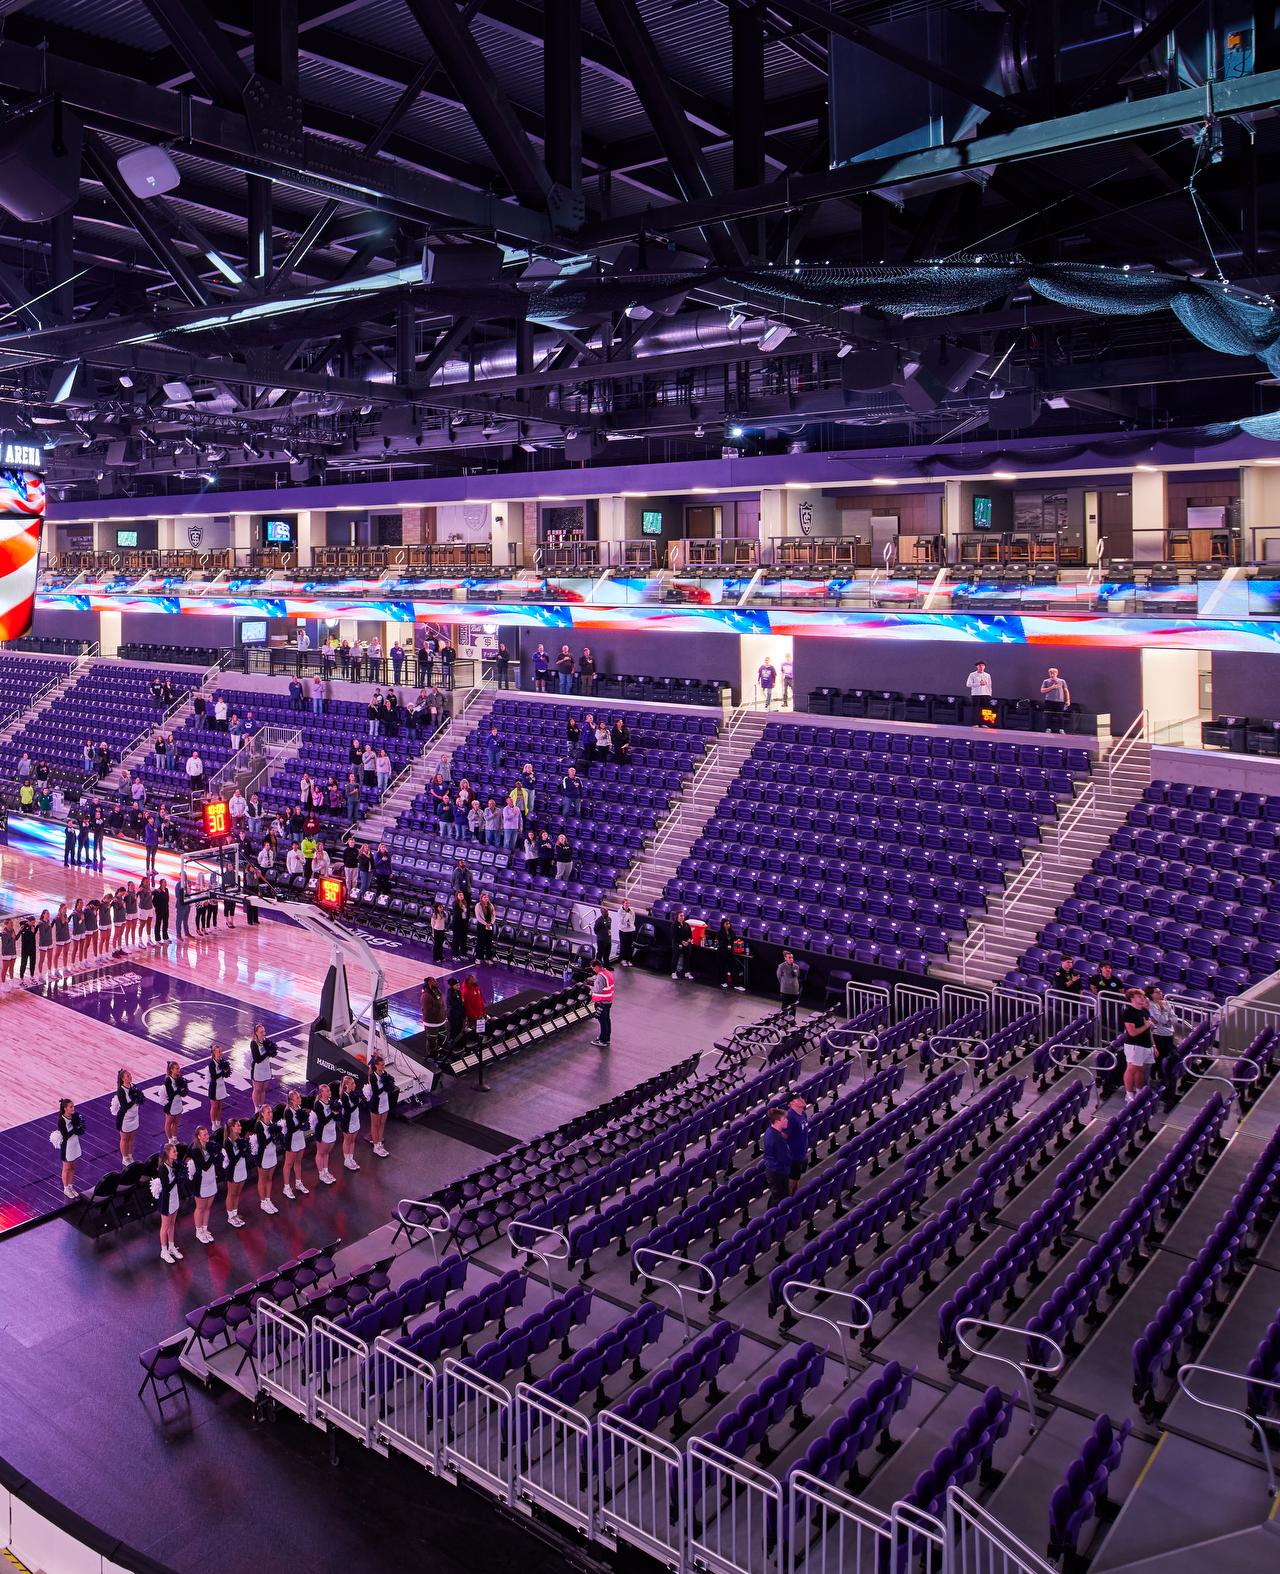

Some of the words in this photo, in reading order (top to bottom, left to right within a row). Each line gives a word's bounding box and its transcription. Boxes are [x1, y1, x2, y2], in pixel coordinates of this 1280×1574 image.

[5, 444, 41, 466] ARENA
[209, 814, 224, 832] 30
[324, 889, 336, 902] 30
